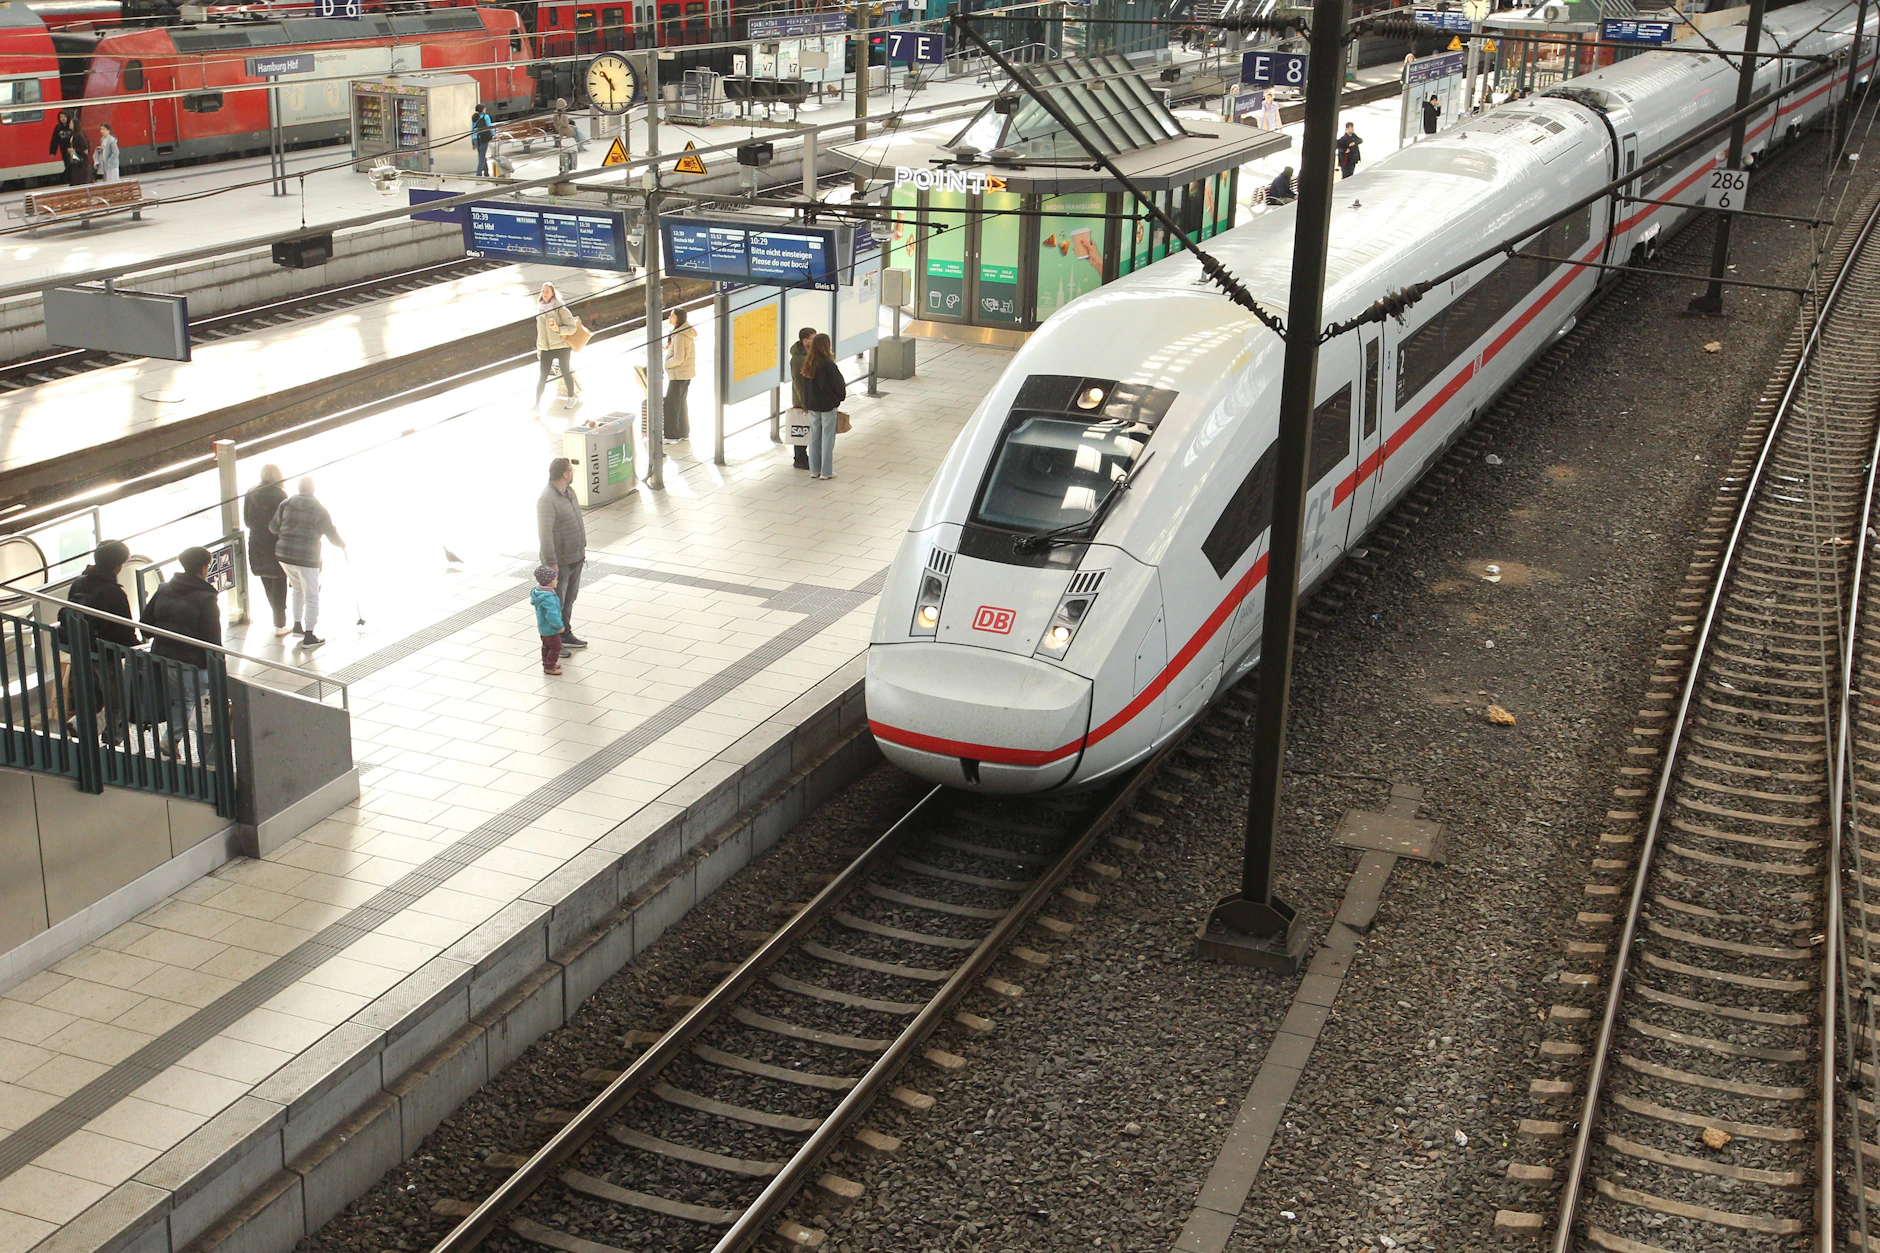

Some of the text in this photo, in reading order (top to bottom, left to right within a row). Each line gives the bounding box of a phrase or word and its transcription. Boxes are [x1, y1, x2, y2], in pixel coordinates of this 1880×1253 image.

[322, 0, 357, 18] D 6
[889, 34, 931, 60] 7 E
[257, 59, 299, 73] Hamburg Hbf
[735, 61, 744, 70] r7
[763, 62, 773, 72] v7
[789, 64, 797, 73] t7
[1255, 56, 1302, 83] E 8
[894, 165, 986, 196] POINT
[1710, 172, 1745, 191] 286
[1718, 191, 1730, 208] 6
[1046, 203, 1064, 211] MOIN
[472, 213, 489, 221] 10:39
[473, 222, 495, 231] Kiel Hbf
[750, 237, 768, 246] 10:29
[466, 250, 485, 258] Gleis 7
[750, 246, 813, 261] Bitte nicht einsteigen
[752, 257, 809, 269] Please do not board
[815, 282, 830, 290] Gleis
[1400, 349, 1405, 375] 2
[791, 426, 809, 437] SAP
[591, 453, 600, 494] Abfall
[1300, 486, 1332, 563] CE
[976, 609, 1011, 631] DB
